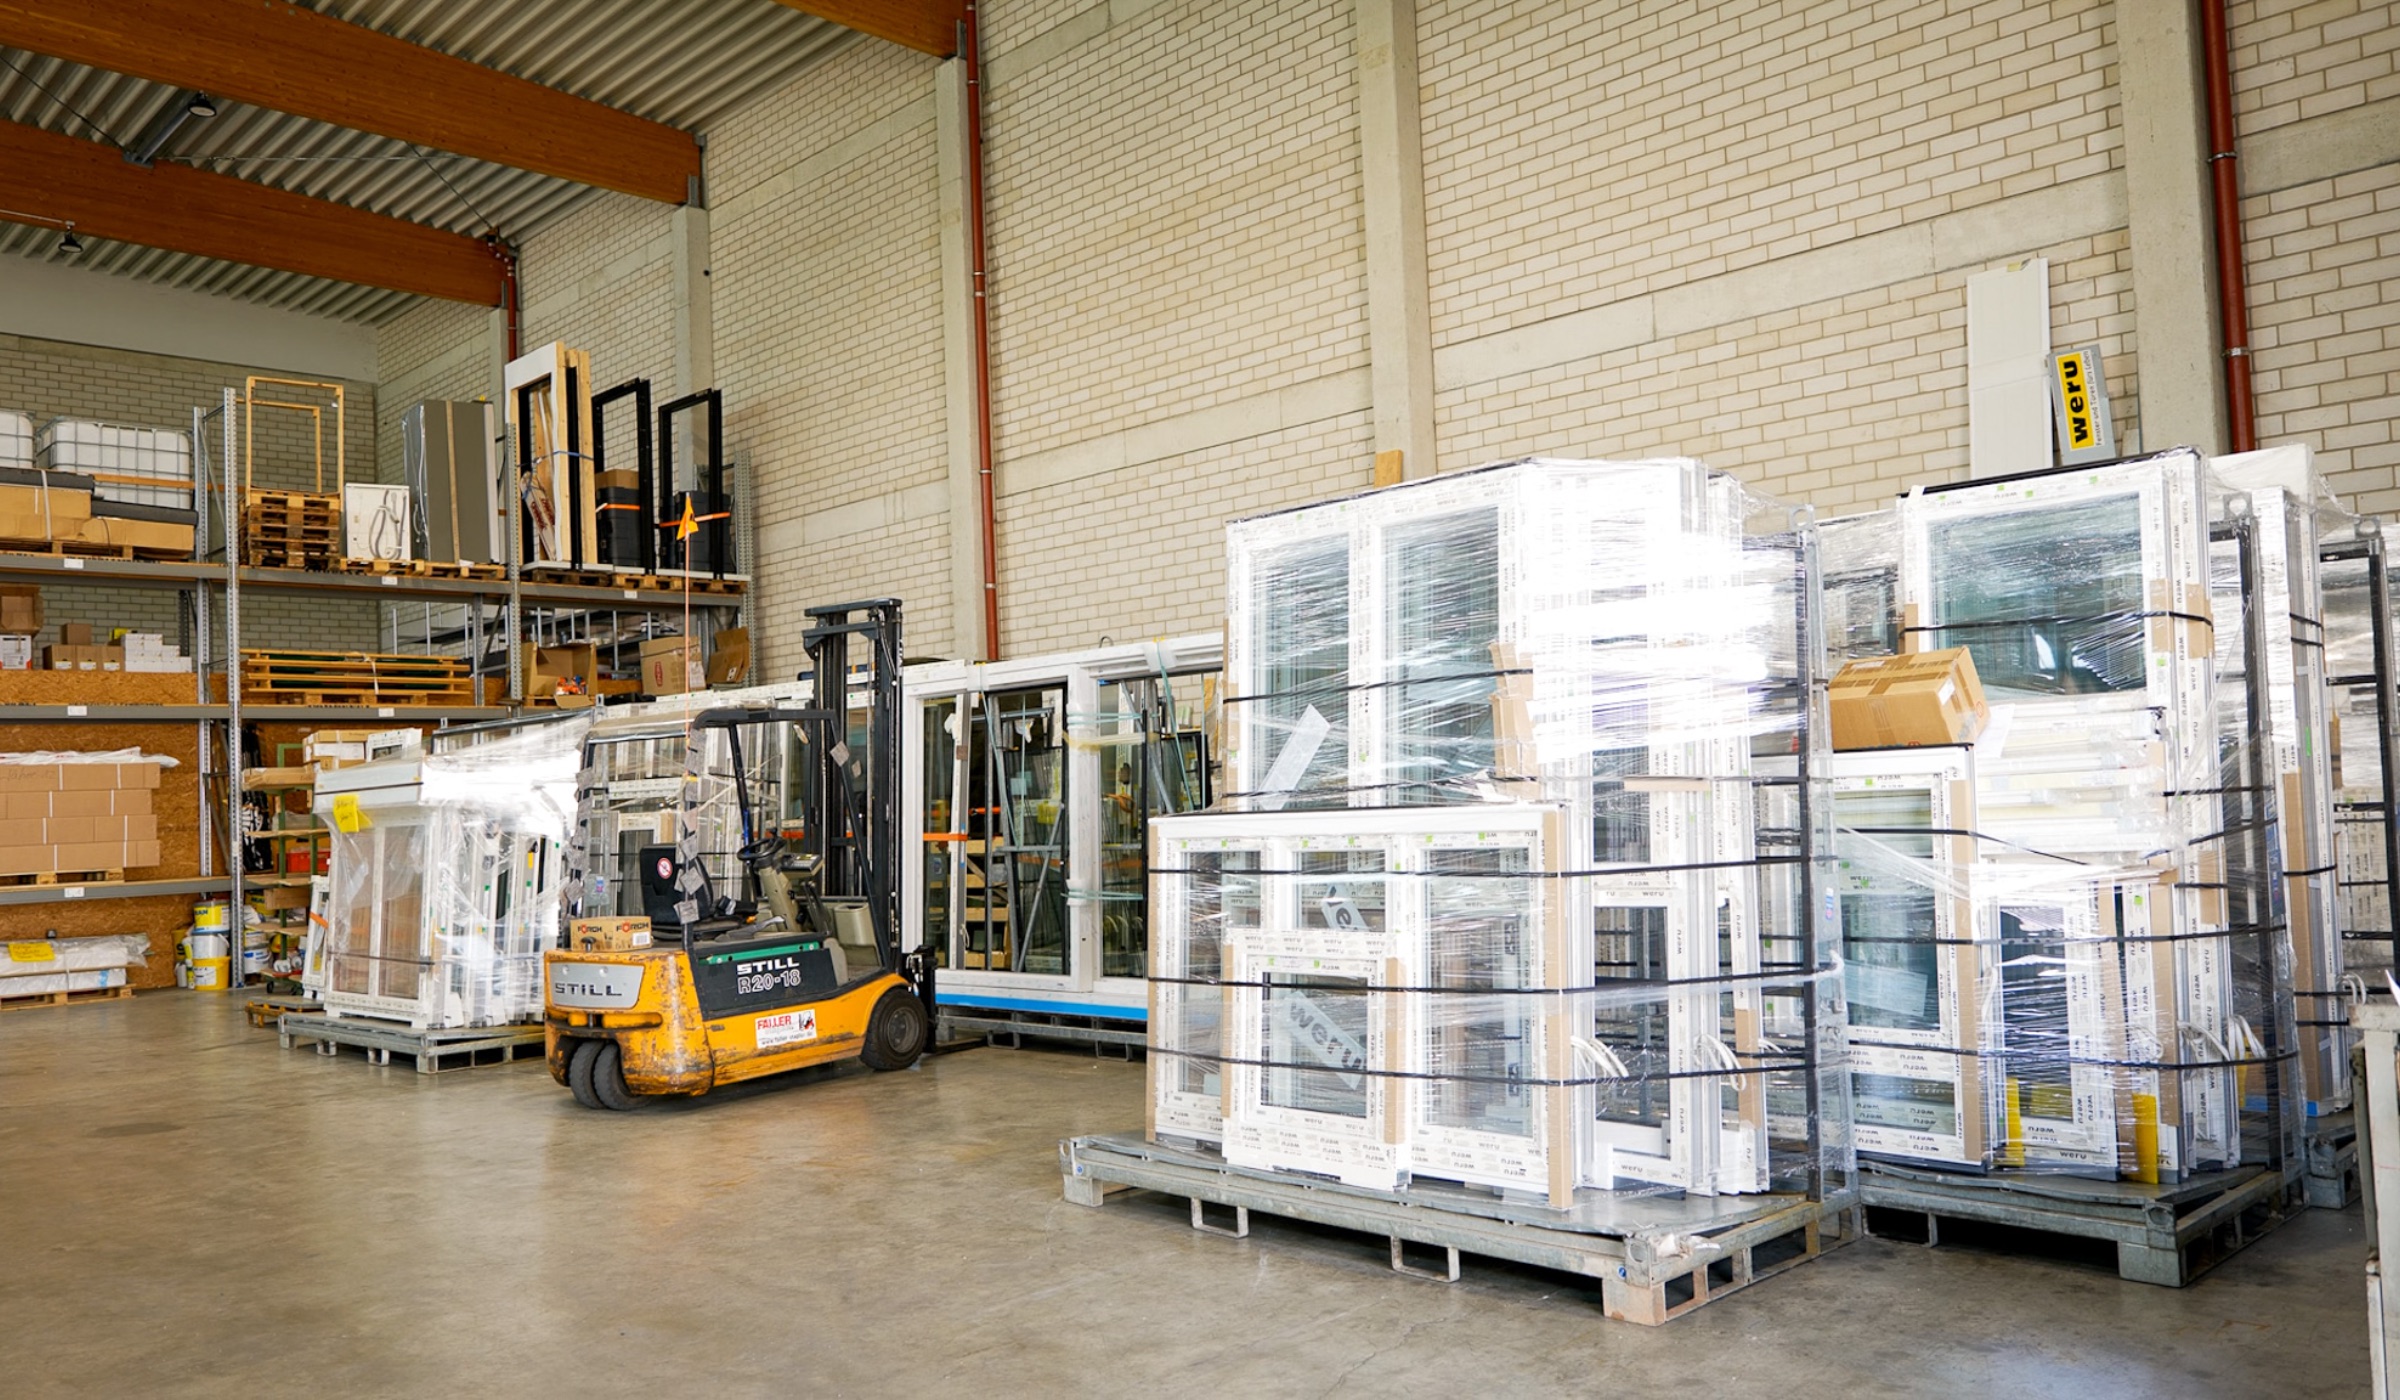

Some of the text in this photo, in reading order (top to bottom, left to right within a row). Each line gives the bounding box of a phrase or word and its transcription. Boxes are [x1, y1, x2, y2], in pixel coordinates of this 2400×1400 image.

[2063, 360, 2088, 443] weru
[736, 957, 800, 975] STILL
[555, 982, 622, 996] STILL
[1290, 1003, 1362, 1069] weru
[2028, 1126, 2054, 1134] weru
[1478, 1142, 1500, 1150] weru
[1913, 1144, 1939, 1152] weru
[1322, 1147, 1341, 1155] weru
[2059, 1150, 2087, 1160] weru
[1454, 1161, 1475, 1169] weru
[1621, 1164, 1643, 1173] weru
[1504, 1168, 1526, 1177] weru
